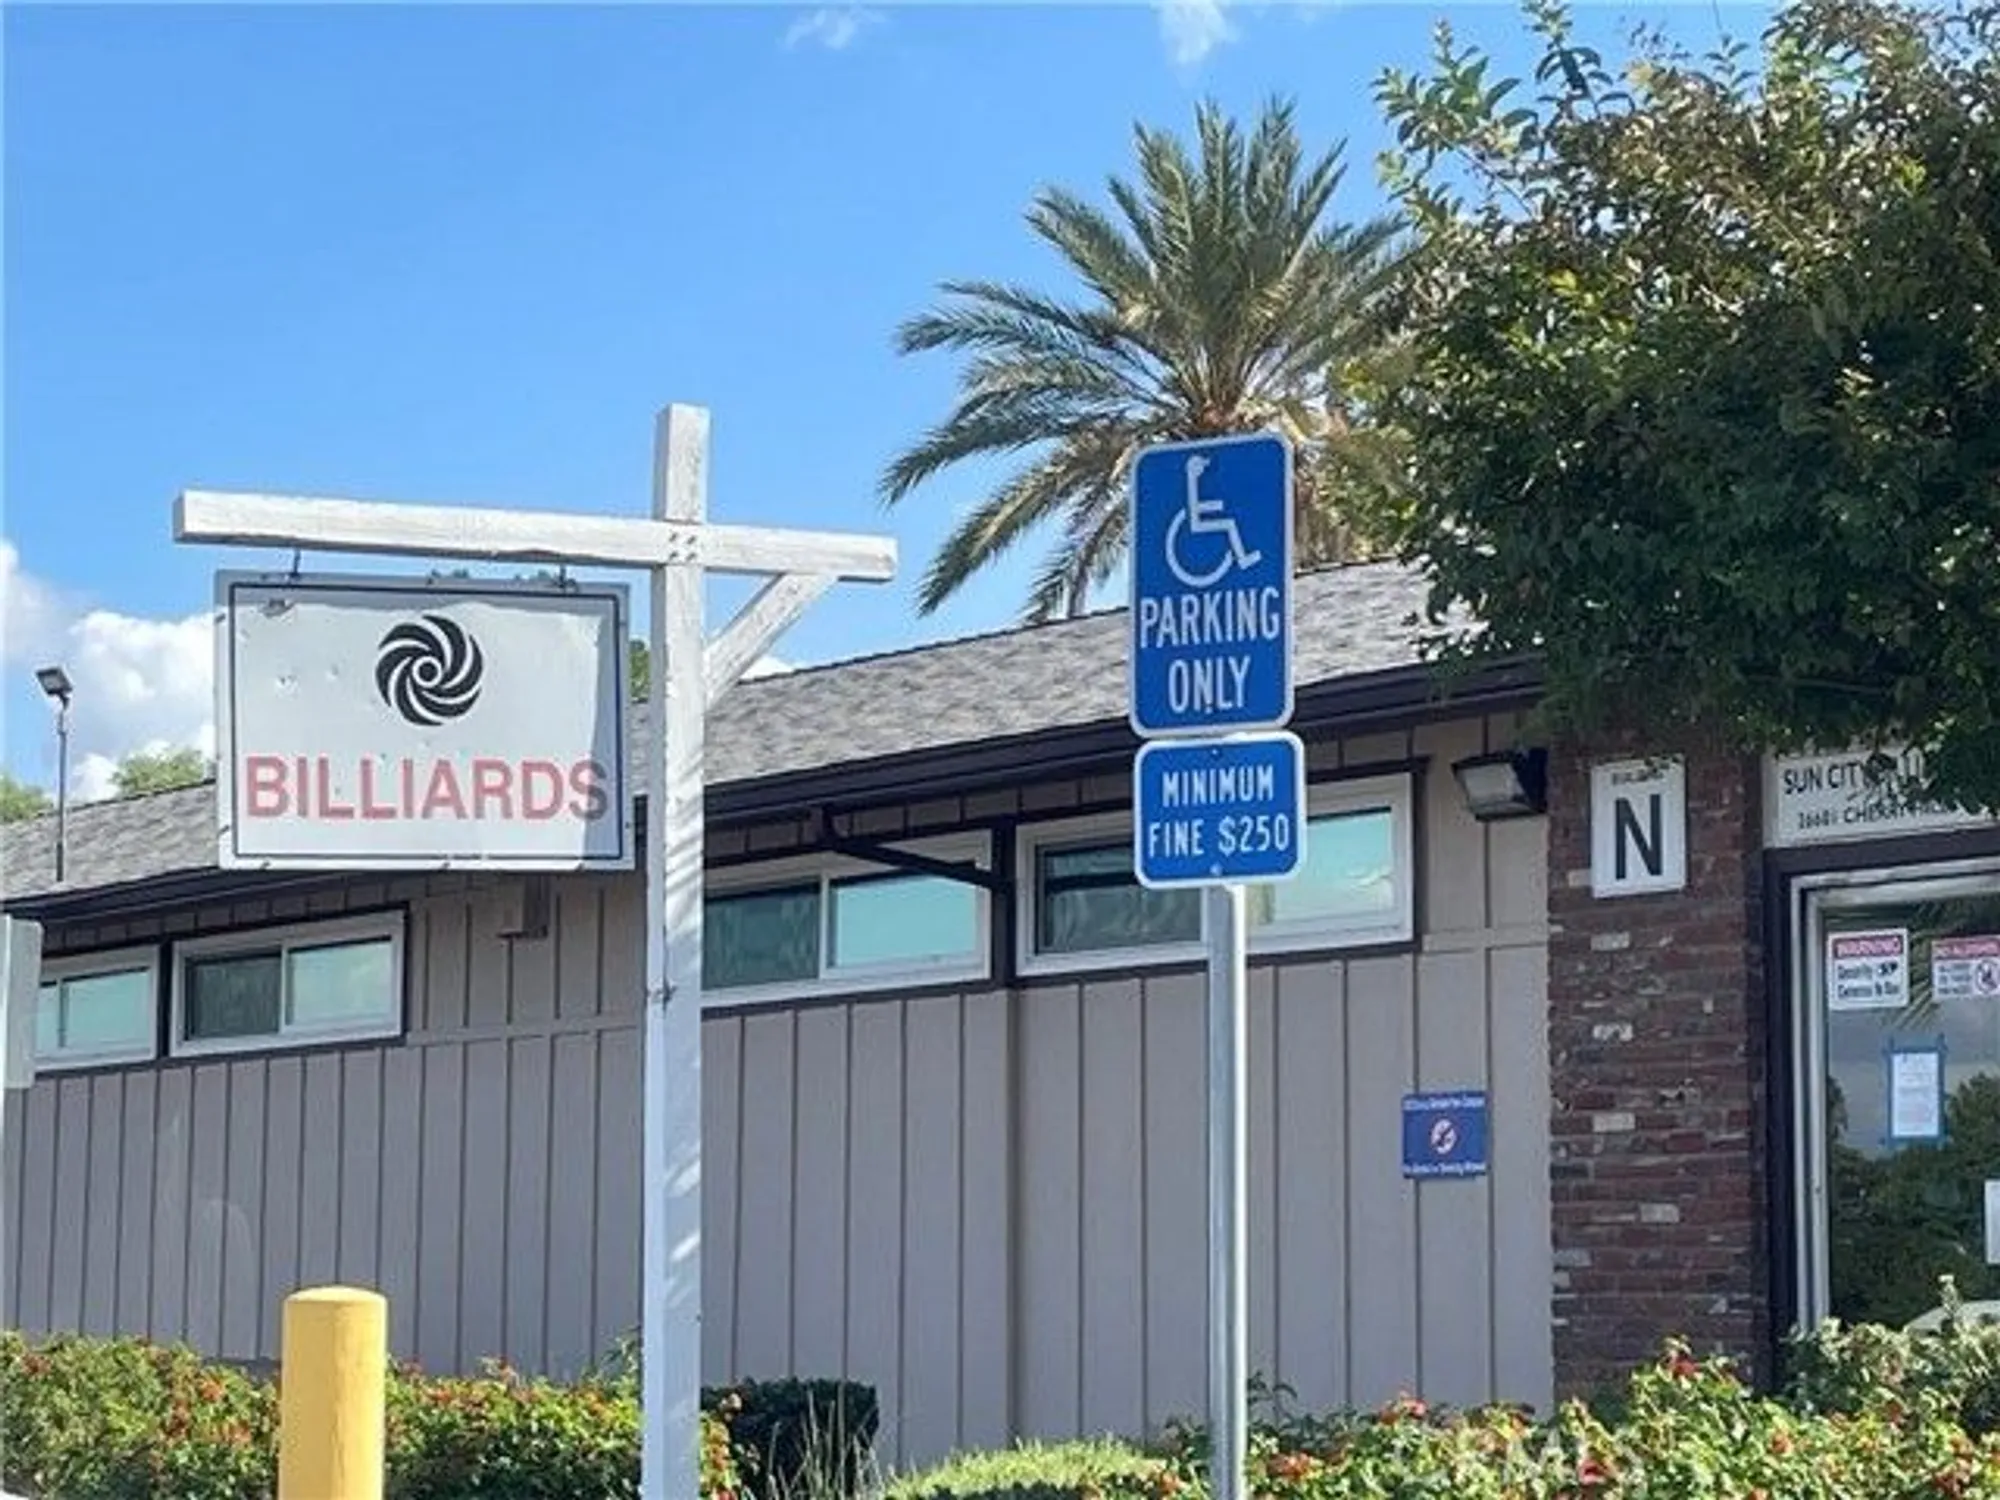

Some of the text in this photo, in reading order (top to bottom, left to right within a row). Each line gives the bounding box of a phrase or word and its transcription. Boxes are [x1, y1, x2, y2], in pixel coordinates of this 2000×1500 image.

[1140, 587, 1280, 649] PARKING
[1168, 656, 1251, 713] ONLY
[245, 755, 609, 822] BILLIARDS
[1162, 764, 1274, 808] MINIMUM
[1783, 764, 1824, 795] SUN
[1148, 812, 1290, 859] FINE $250
[1614, 793, 1663, 880] N
